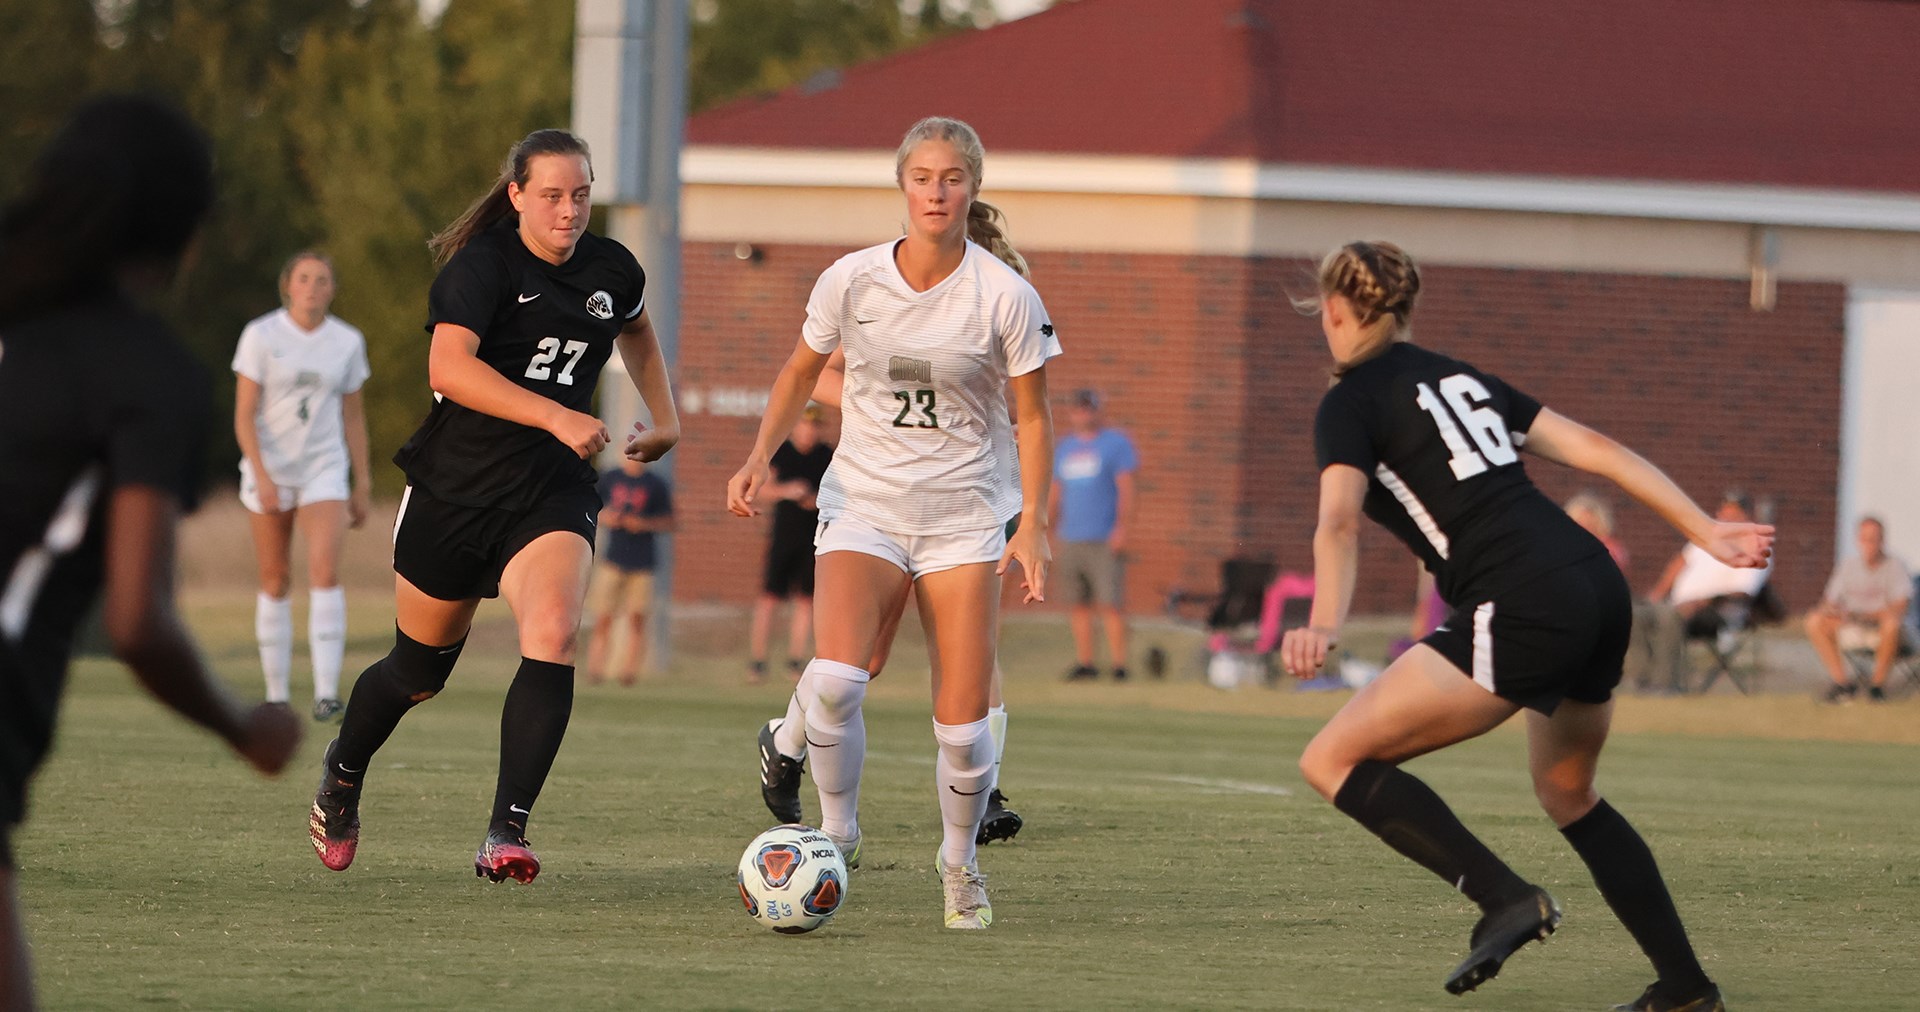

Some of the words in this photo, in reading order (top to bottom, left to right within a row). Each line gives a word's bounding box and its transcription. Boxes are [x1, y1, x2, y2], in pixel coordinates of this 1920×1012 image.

[524, 337, 589, 386] 27
[893, 389, 939, 428] 23
[1416, 373, 1518, 480] 16
[811, 849, 835, 859] NCAA
